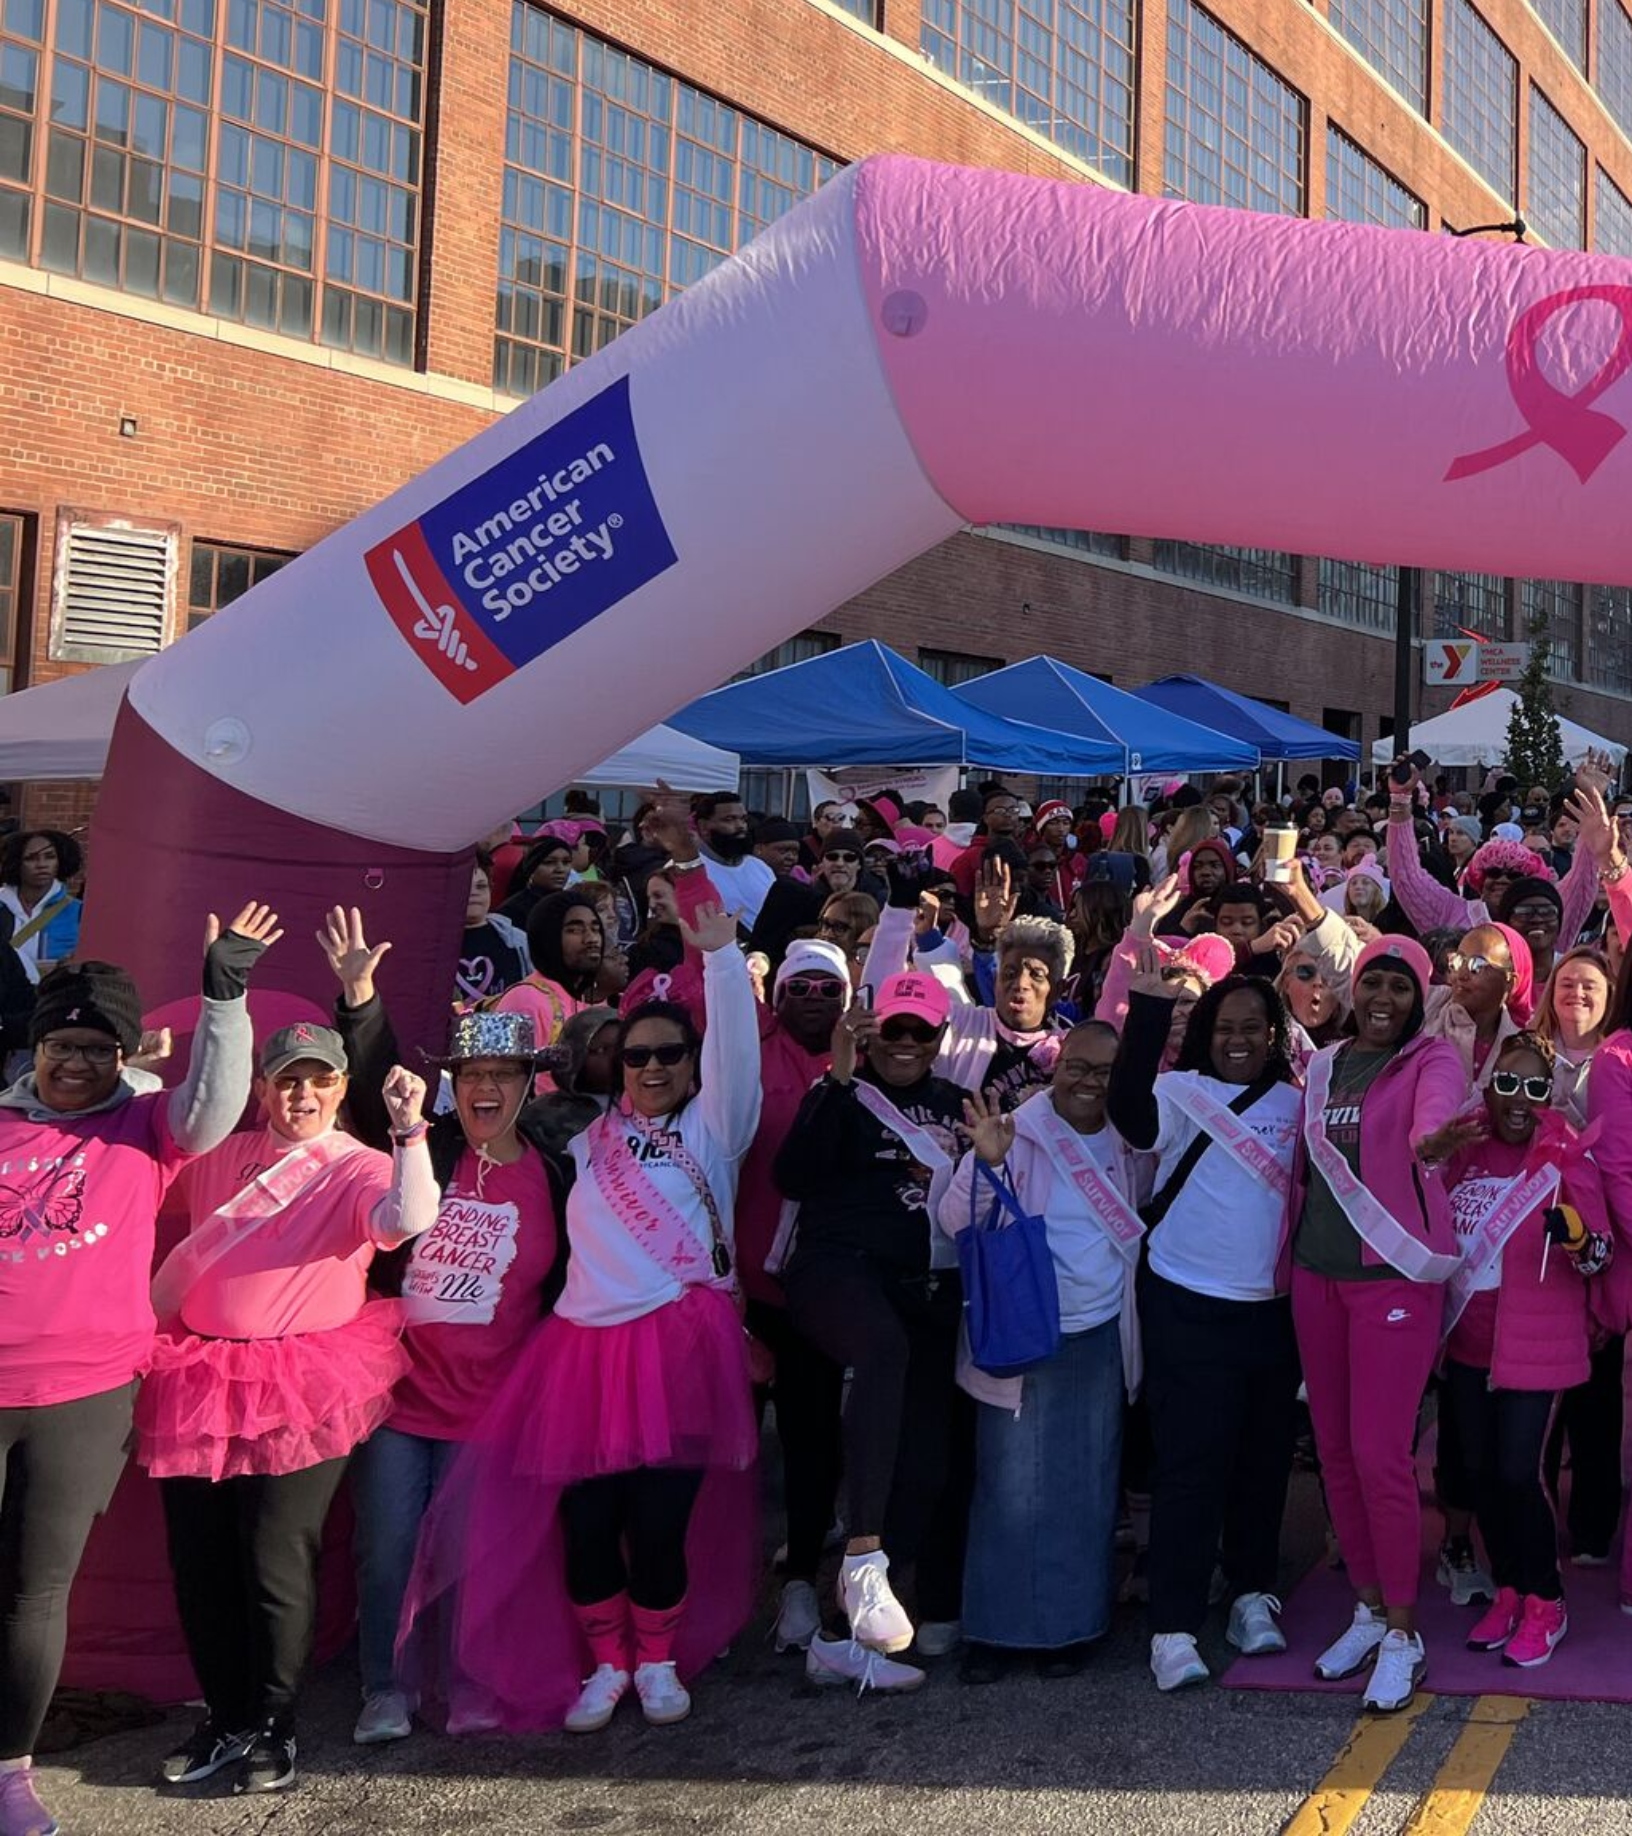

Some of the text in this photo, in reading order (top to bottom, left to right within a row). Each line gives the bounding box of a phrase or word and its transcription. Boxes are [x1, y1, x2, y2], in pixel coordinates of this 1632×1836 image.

[450, 442, 616, 565] American
[463, 498, 584, 589] Cancer
[440, 1201, 510, 1232] ENDING
[604, 1149, 659, 1231] Survivor
[1079, 1172, 1132, 1237] Survivor
[1487, 1171, 1548, 1238] Survivor
[419, 1241, 496, 1275] CANCER
[429, 1219, 507, 1251] BREAST
